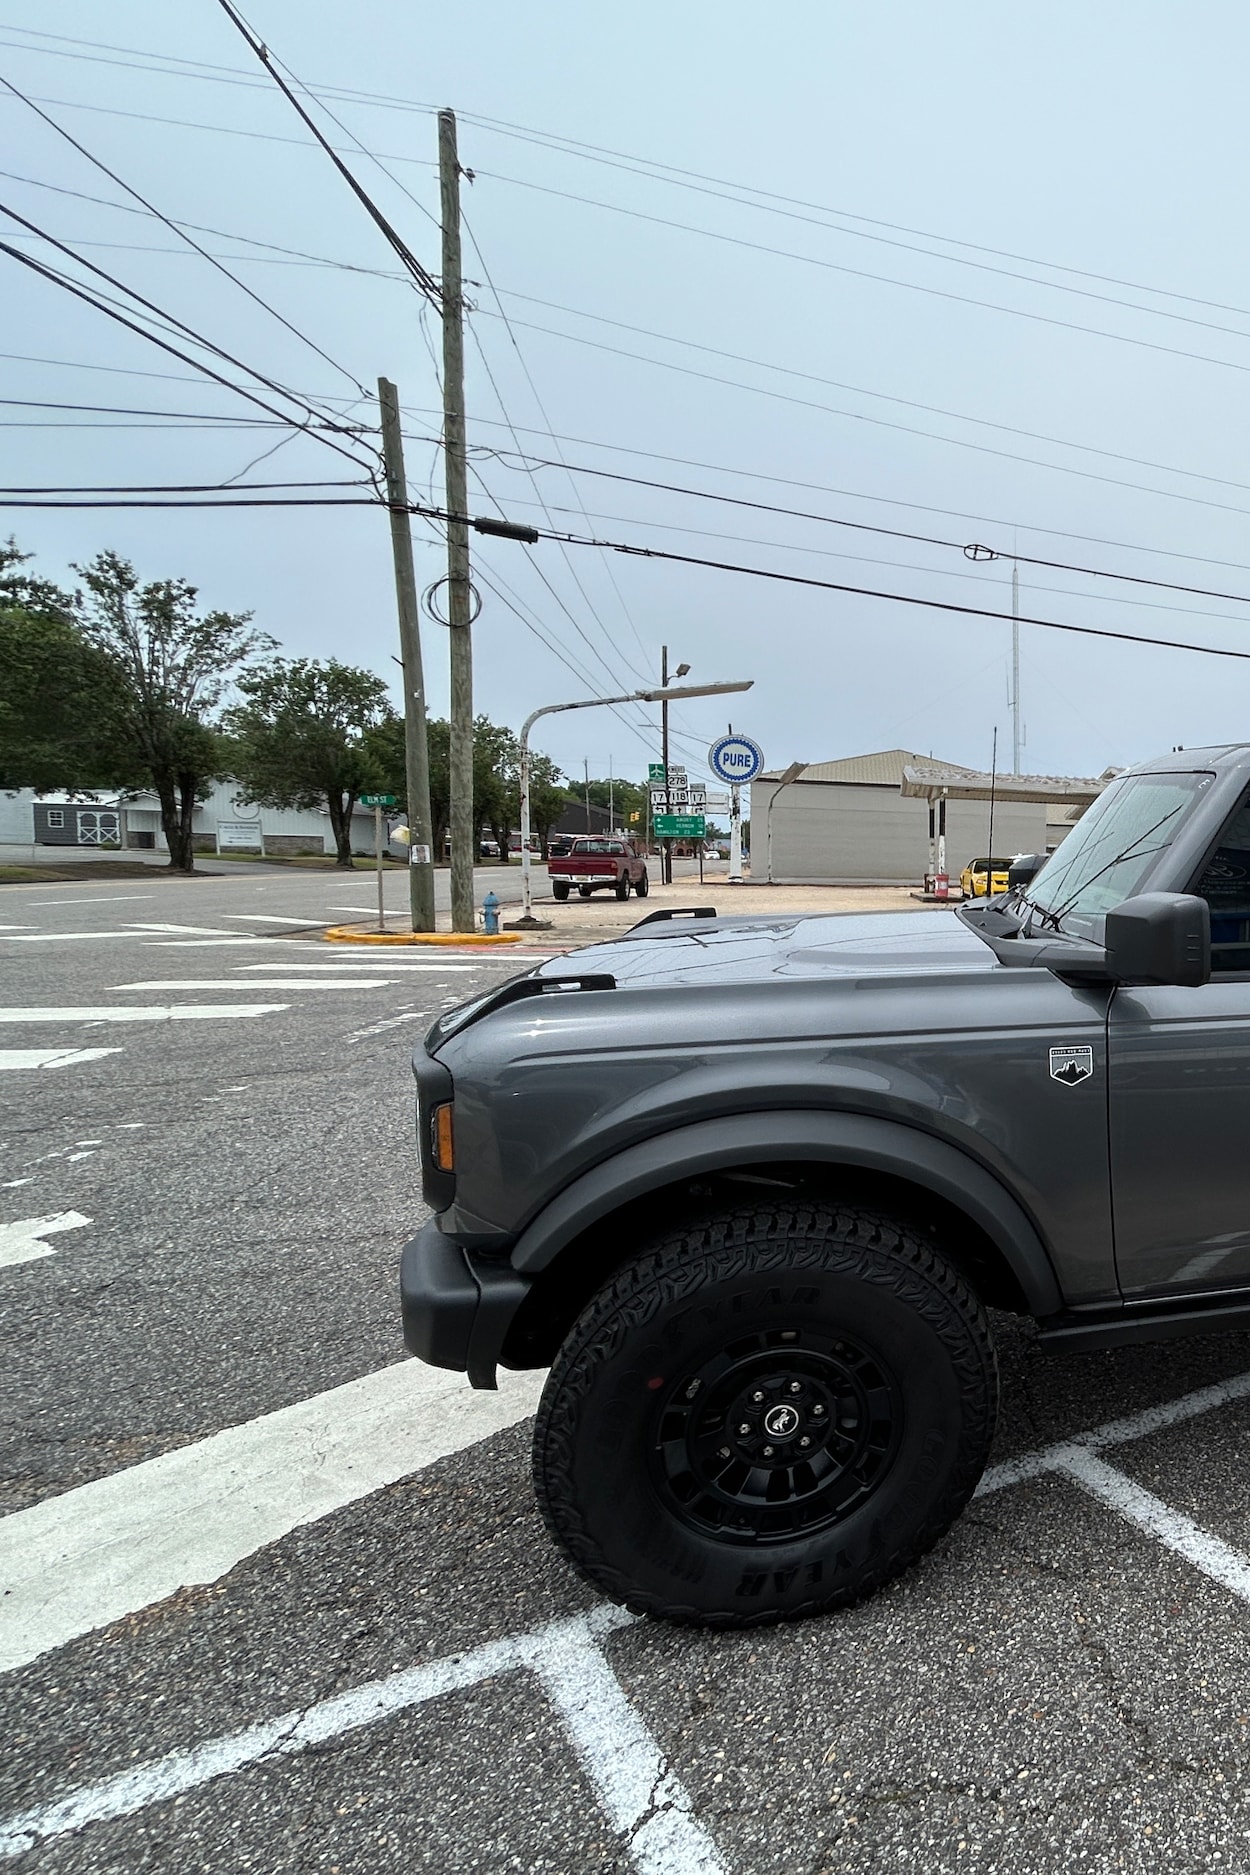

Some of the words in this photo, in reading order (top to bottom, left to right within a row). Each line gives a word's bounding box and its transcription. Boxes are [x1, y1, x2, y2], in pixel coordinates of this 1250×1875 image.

[723, 752, 751, 768] PURE
[669, 776, 686, 785] 278
[653, 793, 663, 802] 17
[672, 792, 686, 801] 118
[693, 793, 703, 802] 17
